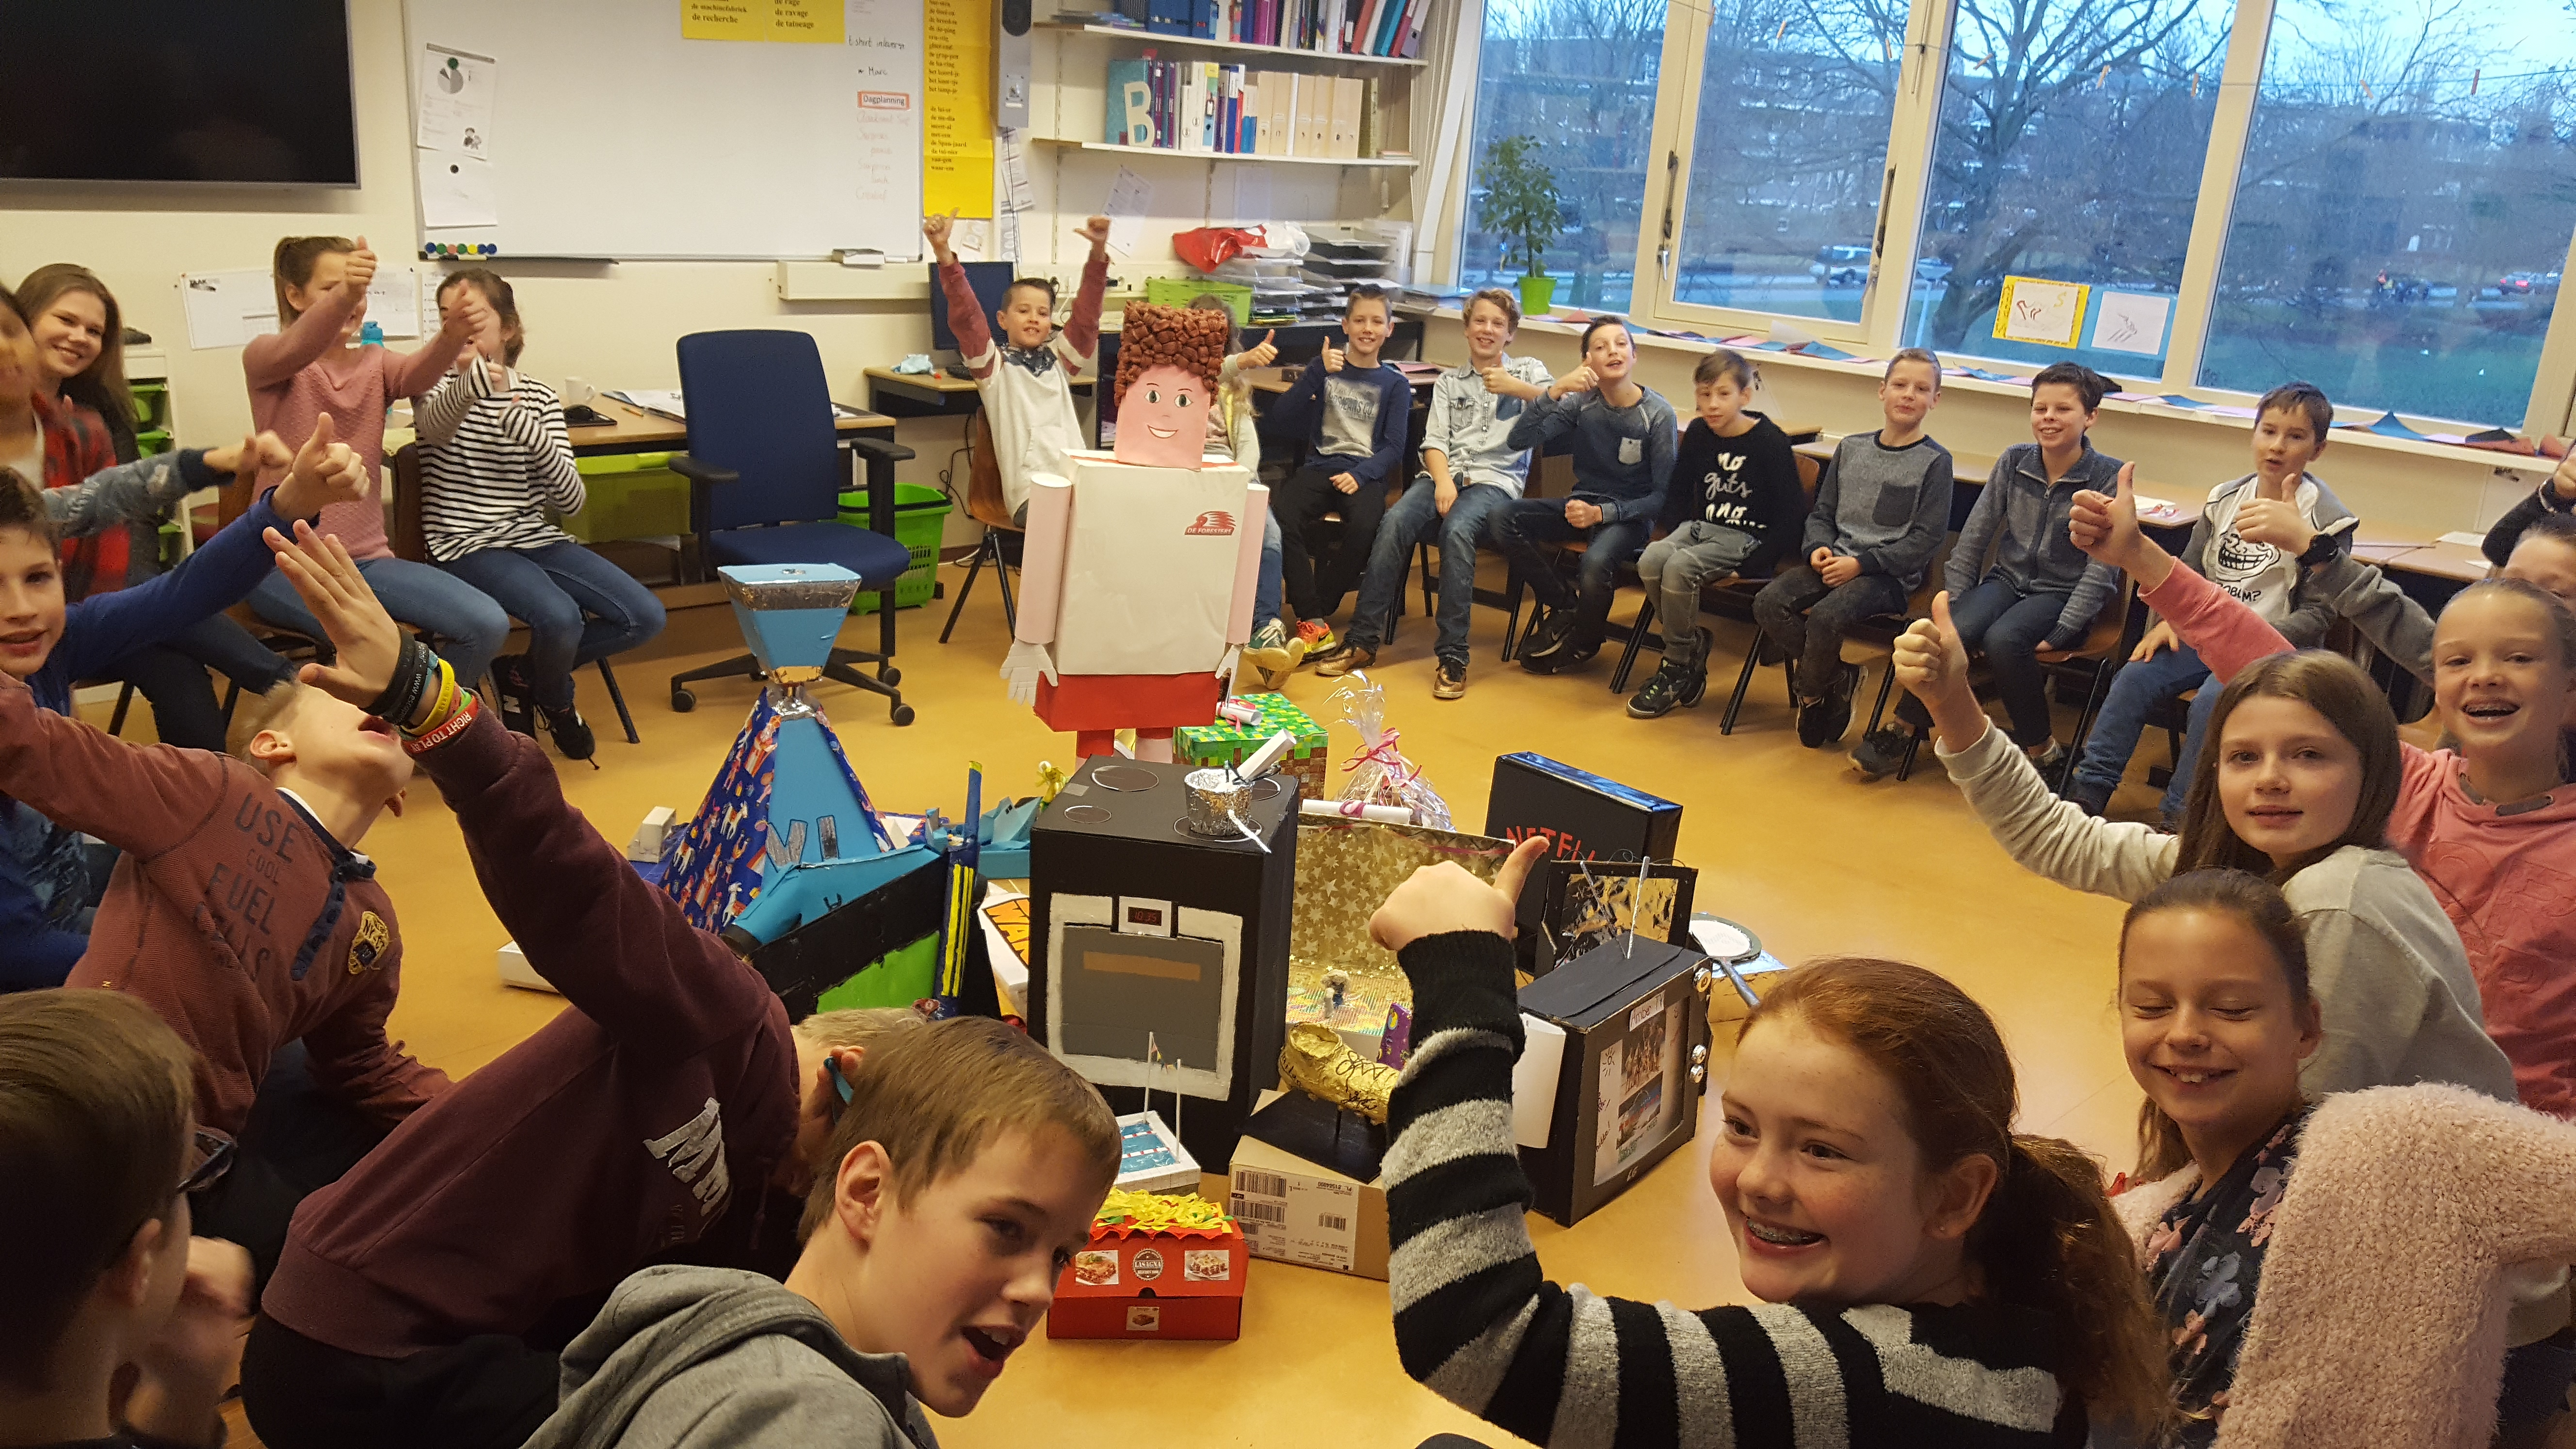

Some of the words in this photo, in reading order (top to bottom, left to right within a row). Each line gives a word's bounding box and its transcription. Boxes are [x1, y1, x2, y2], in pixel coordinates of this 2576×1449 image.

[703, 14, 738, 23] recherche
[775, 8, 782, 16] de
[776, 19, 783, 28] de
[863, 95, 904, 106] Dagplanning
[1124, 81, 1155, 147] B
[1718, 452, 1747, 471] no
[1704, 472, 1753, 500] guts
[446, 710, 473, 736] RIGHT
[432, 730, 449, 743] TO
[235, 792, 299, 864] USE
[246, 849, 279, 886] COOL
[204, 862, 275, 935] FUEL
